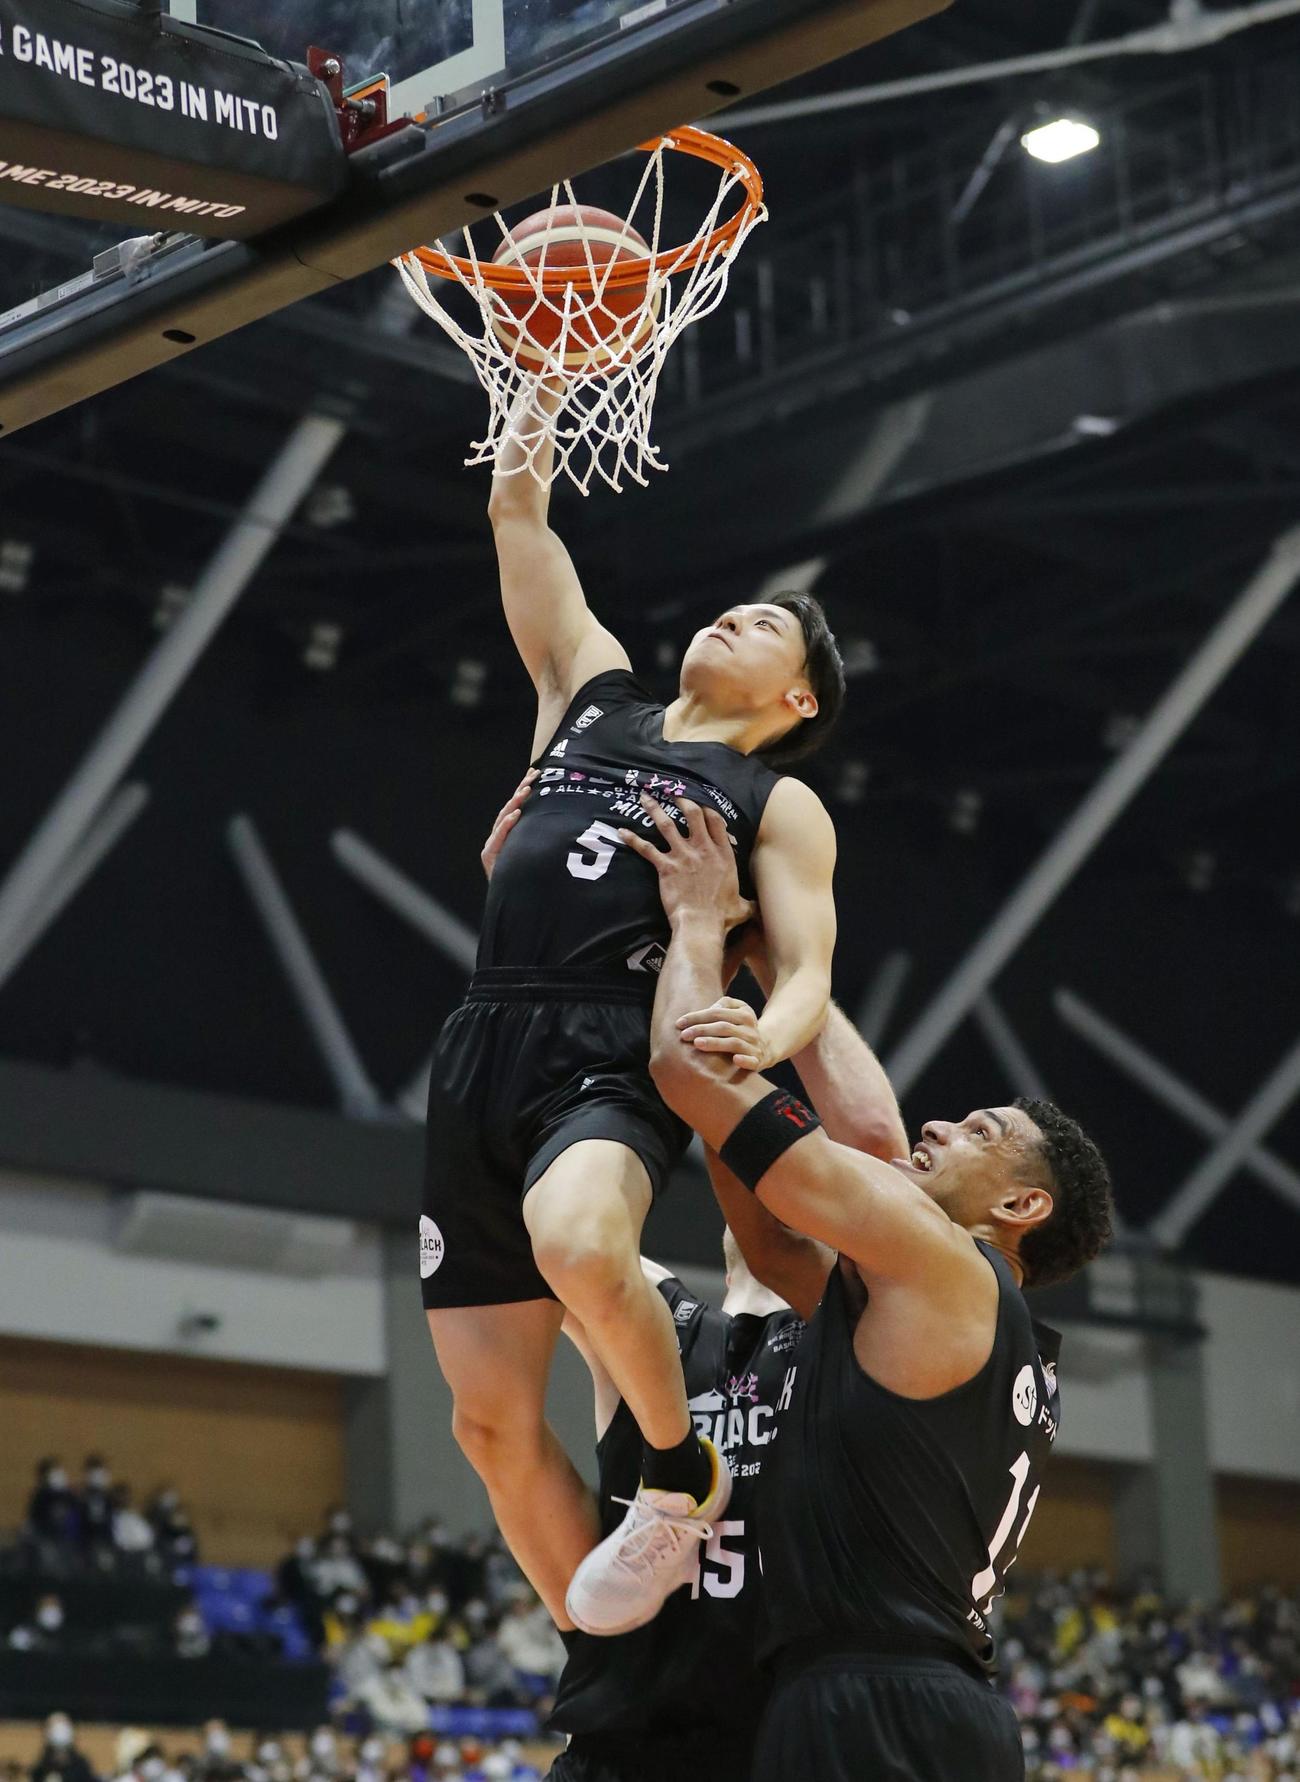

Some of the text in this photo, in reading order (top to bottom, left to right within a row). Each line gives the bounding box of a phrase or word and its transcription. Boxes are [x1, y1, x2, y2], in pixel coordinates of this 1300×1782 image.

[12, 24, 95, 87] GAME
[101, 56, 174, 111] 2023
[181, 81, 208, 121] IN
[214, 90, 278, 141] MITO
[45, 174, 136, 199] 2023
[127, 188, 170, 207] IN
[163, 196, 246, 218] MITO
[555, 784, 584, 793] ALL
[602, 790, 641, 804] STA
[566, 820, 628, 881] 5
[691, 1405, 774, 1454] BLAC
[741, 1461, 762, 1478] 202
